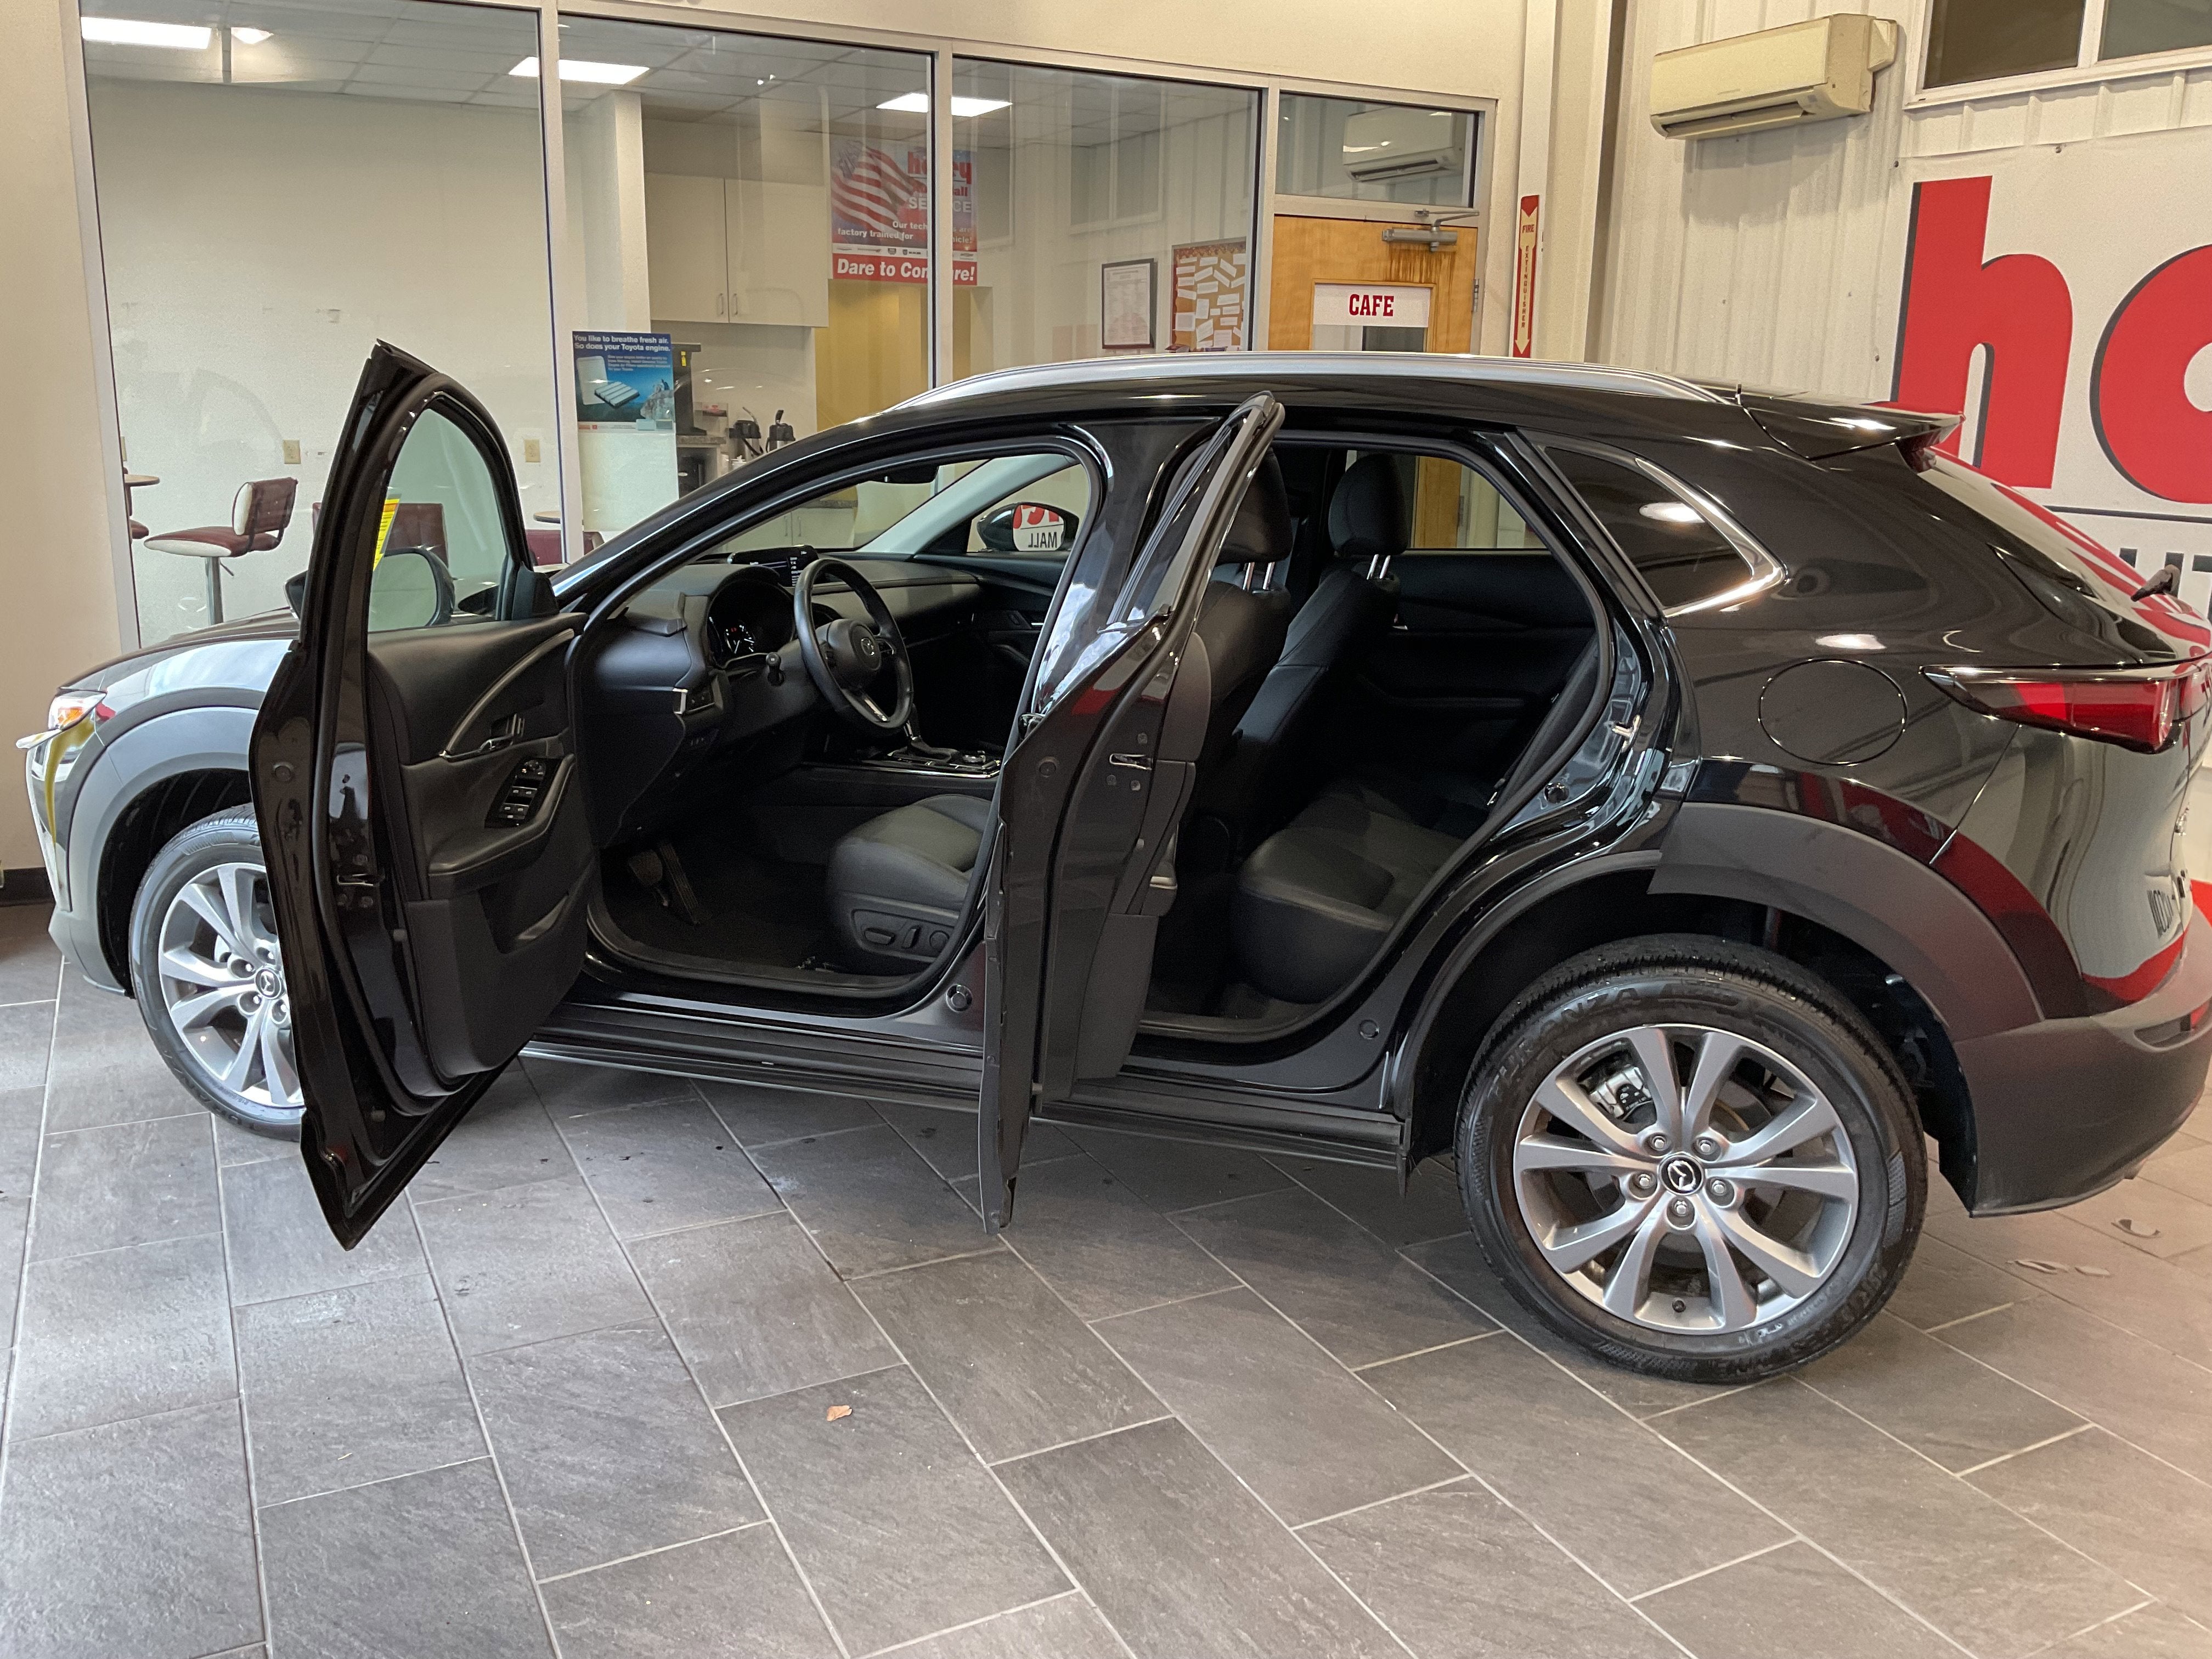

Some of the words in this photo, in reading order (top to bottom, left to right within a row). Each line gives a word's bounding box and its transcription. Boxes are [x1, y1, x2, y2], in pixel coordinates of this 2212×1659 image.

[909, 196, 972, 213] SECE
[893, 221, 907, 229] Our
[1522, 224, 1535, 234] FIRE
[838, 228, 867, 238] factory
[870, 229, 899, 240] trained
[901, 232, 914, 241] for
[837, 258, 874, 275] Dare
[880, 261, 896, 277] to
[1520, 245, 1530, 329] EXTINGUISHER
[1349, 294, 1395, 317] CAFE
[622, 343, 644, 352] Toyota
[645, 345, 670, 353] engine.
